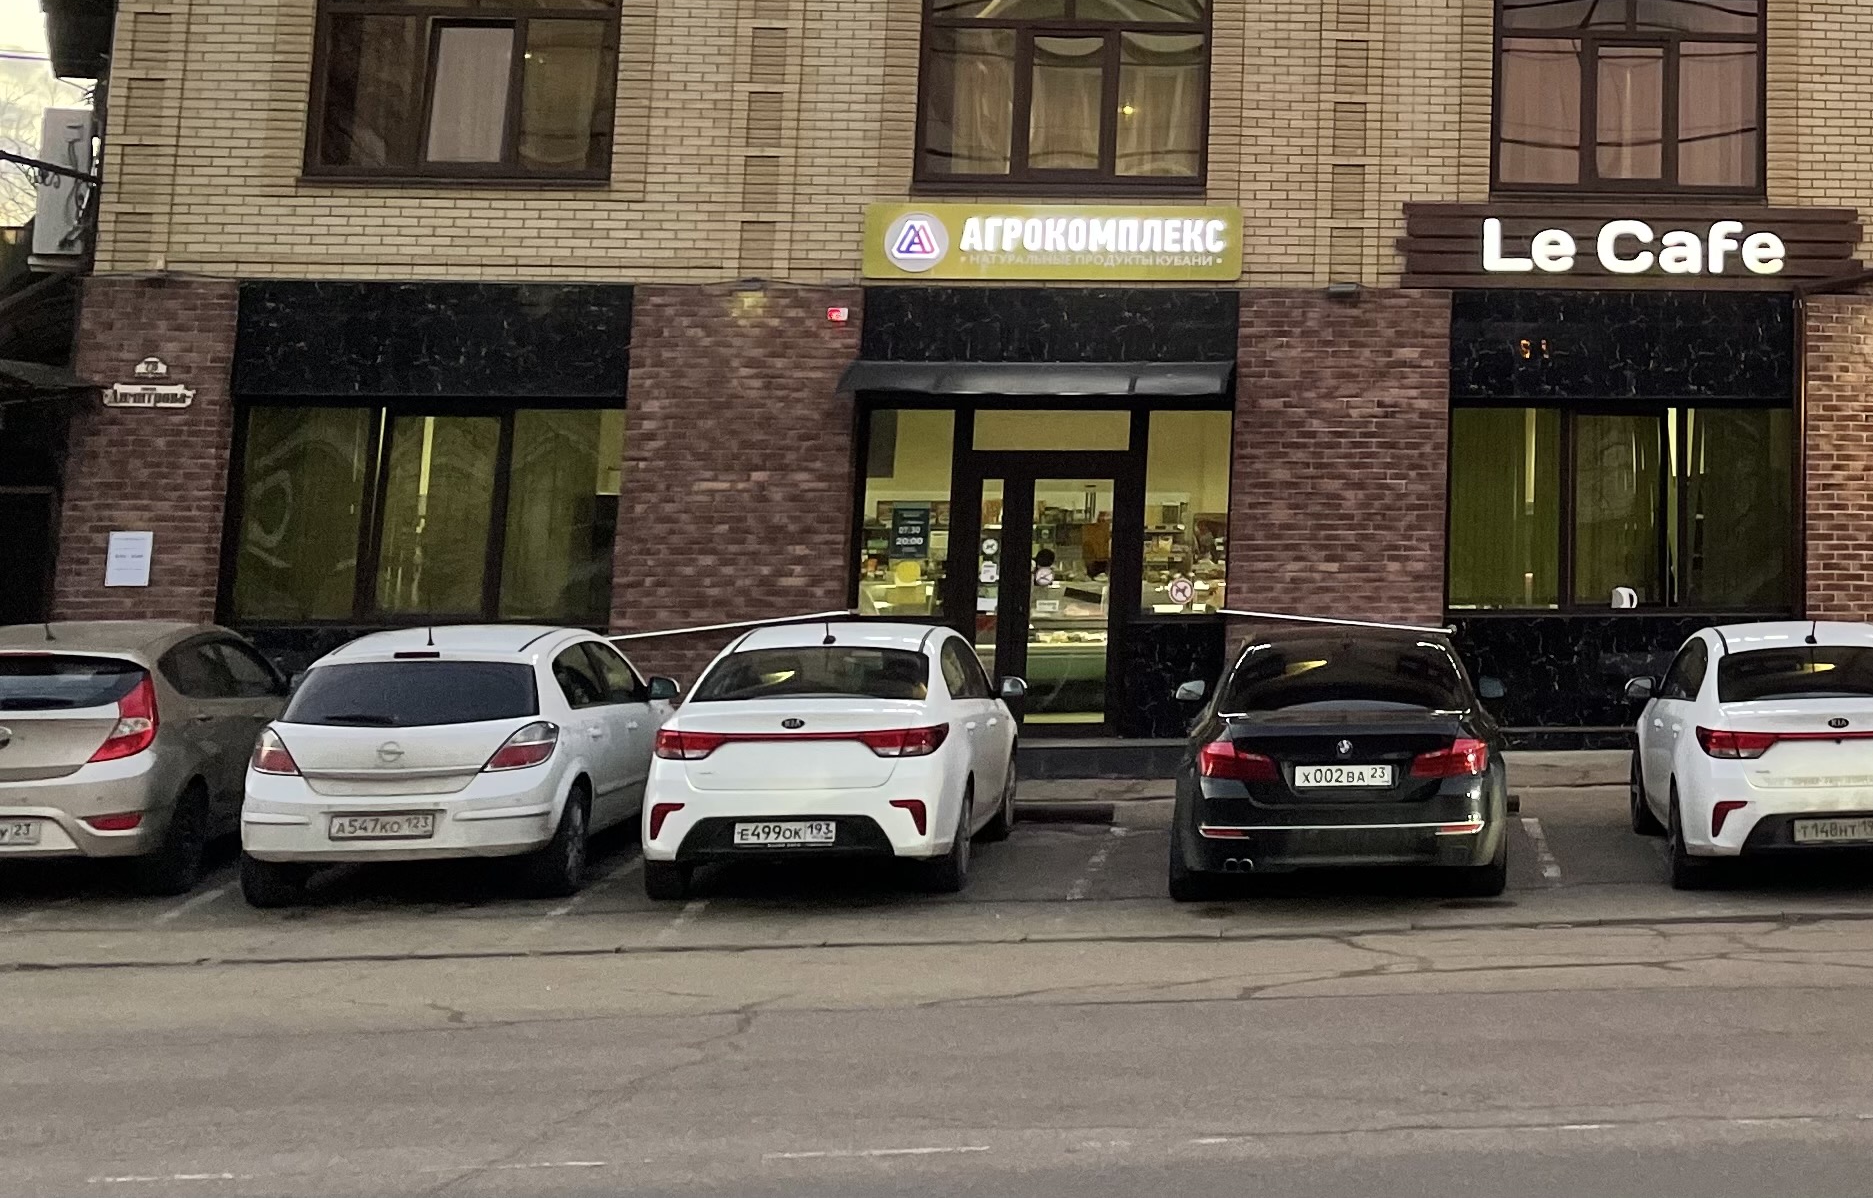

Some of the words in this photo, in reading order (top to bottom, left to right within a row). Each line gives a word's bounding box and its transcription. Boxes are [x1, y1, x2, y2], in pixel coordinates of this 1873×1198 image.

[958, 216, 1226, 253] АГРОКОМПЛЕКС
[1482, 217, 1577, 273] Le
[1596, 218, 1786, 275] Cafe
[969, 254, 1072, 266] НАТУРАЛЬНЫЕ
[1075, 254, 1153, 268] ПРОДУКТЫ
[1155, 255, 1213, 266] КУБАНИ
[895, 537, 924, 545] 20:00
[1302, 768, 1365, 783] Х002ВА
[1370, 767, 1386, 779] 23
[14, 822, 31, 837] 23
[739, 824, 803, 841] Е499ОК
[807, 822, 833, 835] 193
